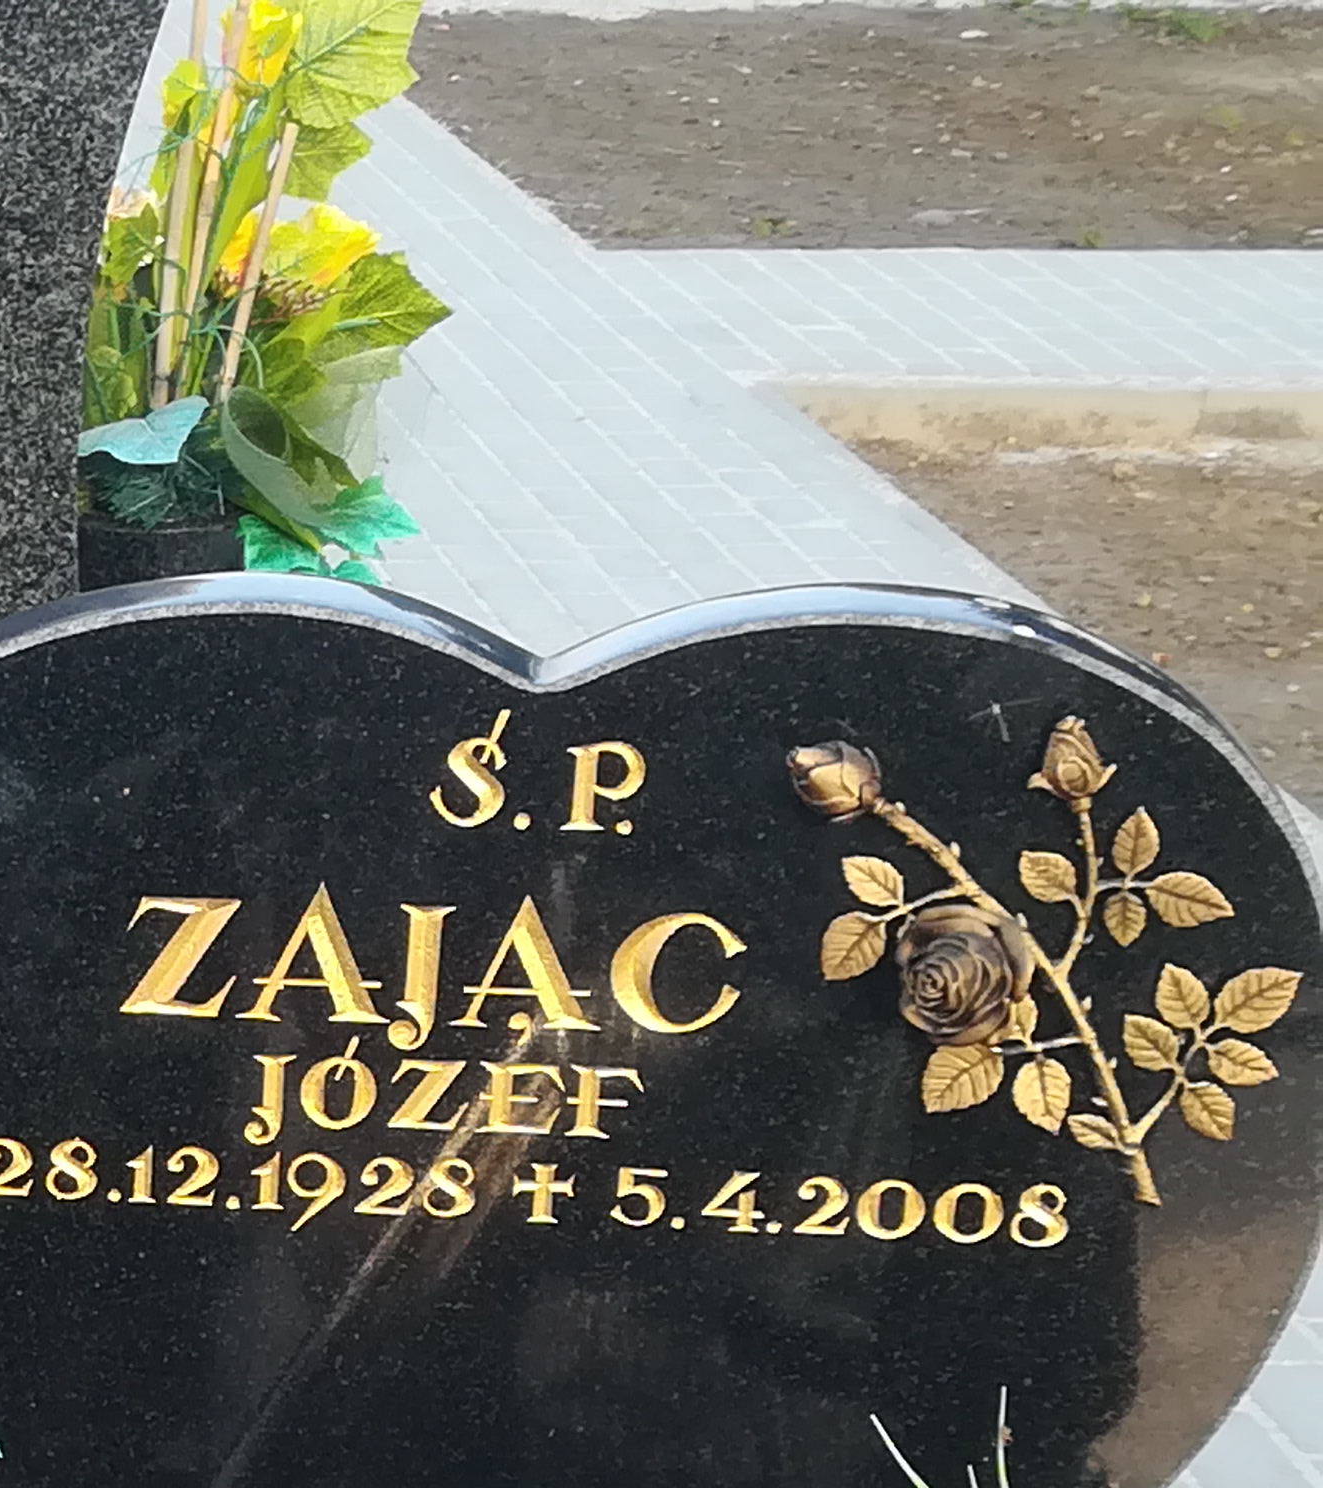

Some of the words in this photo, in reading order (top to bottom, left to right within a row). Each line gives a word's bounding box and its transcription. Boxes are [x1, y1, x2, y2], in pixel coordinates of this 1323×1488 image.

[119, 881, 748, 1050] ZAJĄC
[244, 1035, 645, 1146] JÓZEF
[611, 1168, 1069, 1248] 5.4.2008
